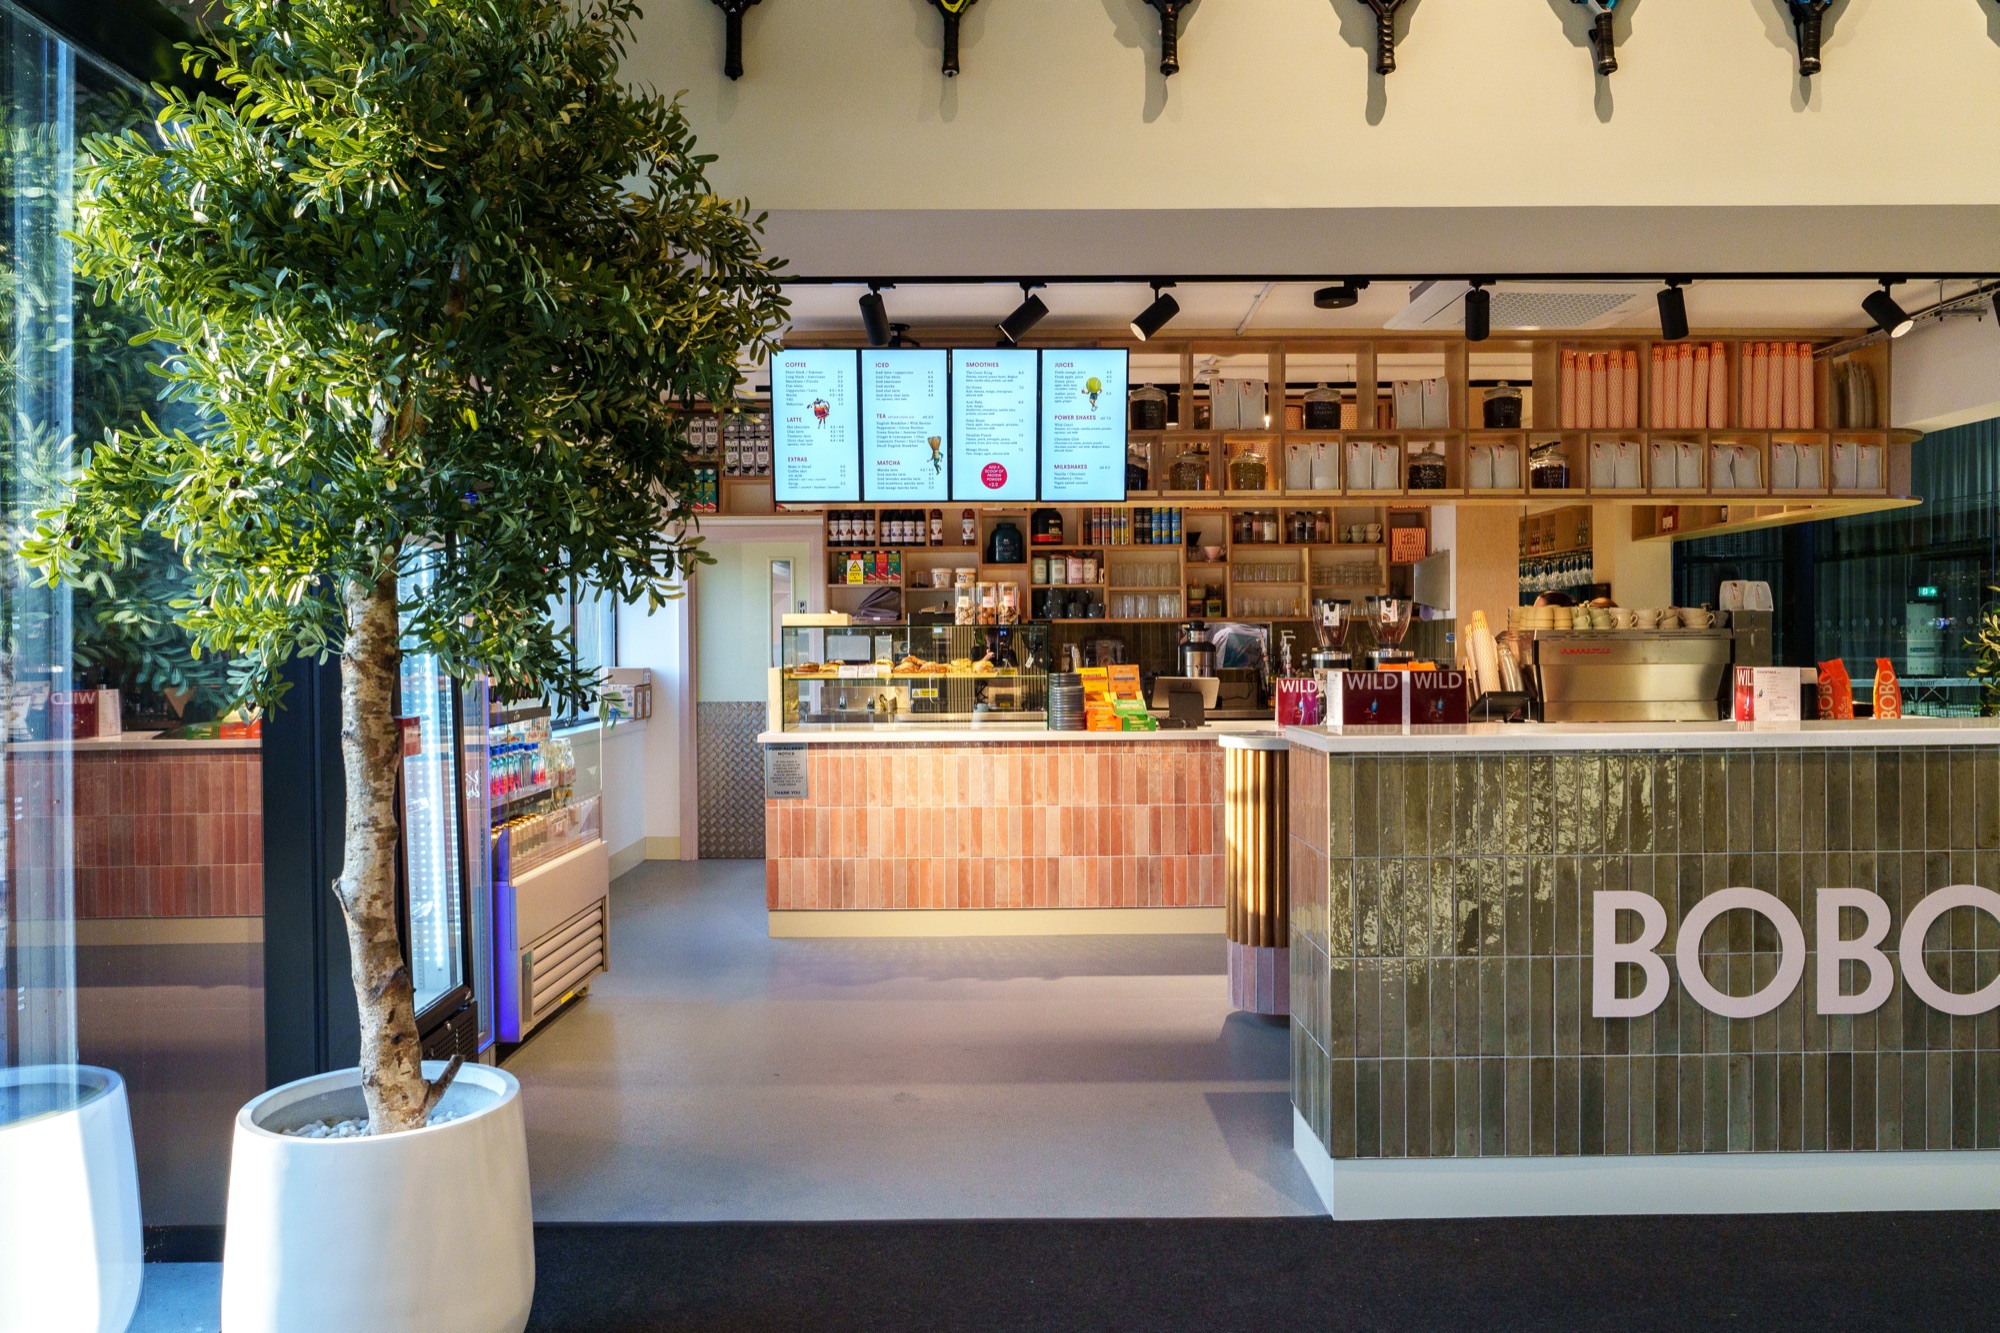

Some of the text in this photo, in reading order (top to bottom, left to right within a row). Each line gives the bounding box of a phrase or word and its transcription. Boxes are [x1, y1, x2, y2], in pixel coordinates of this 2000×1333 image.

[1281, 680, 1317, 693] WILD
[1346, 673, 1398, 690] WILD
[1414, 672, 1462, 689] WILD
[1737, 670, 1753, 686] WIL
[1879, 670, 1898, 720] BOBO
[1593, 884, 2000, 1018] BOBO
